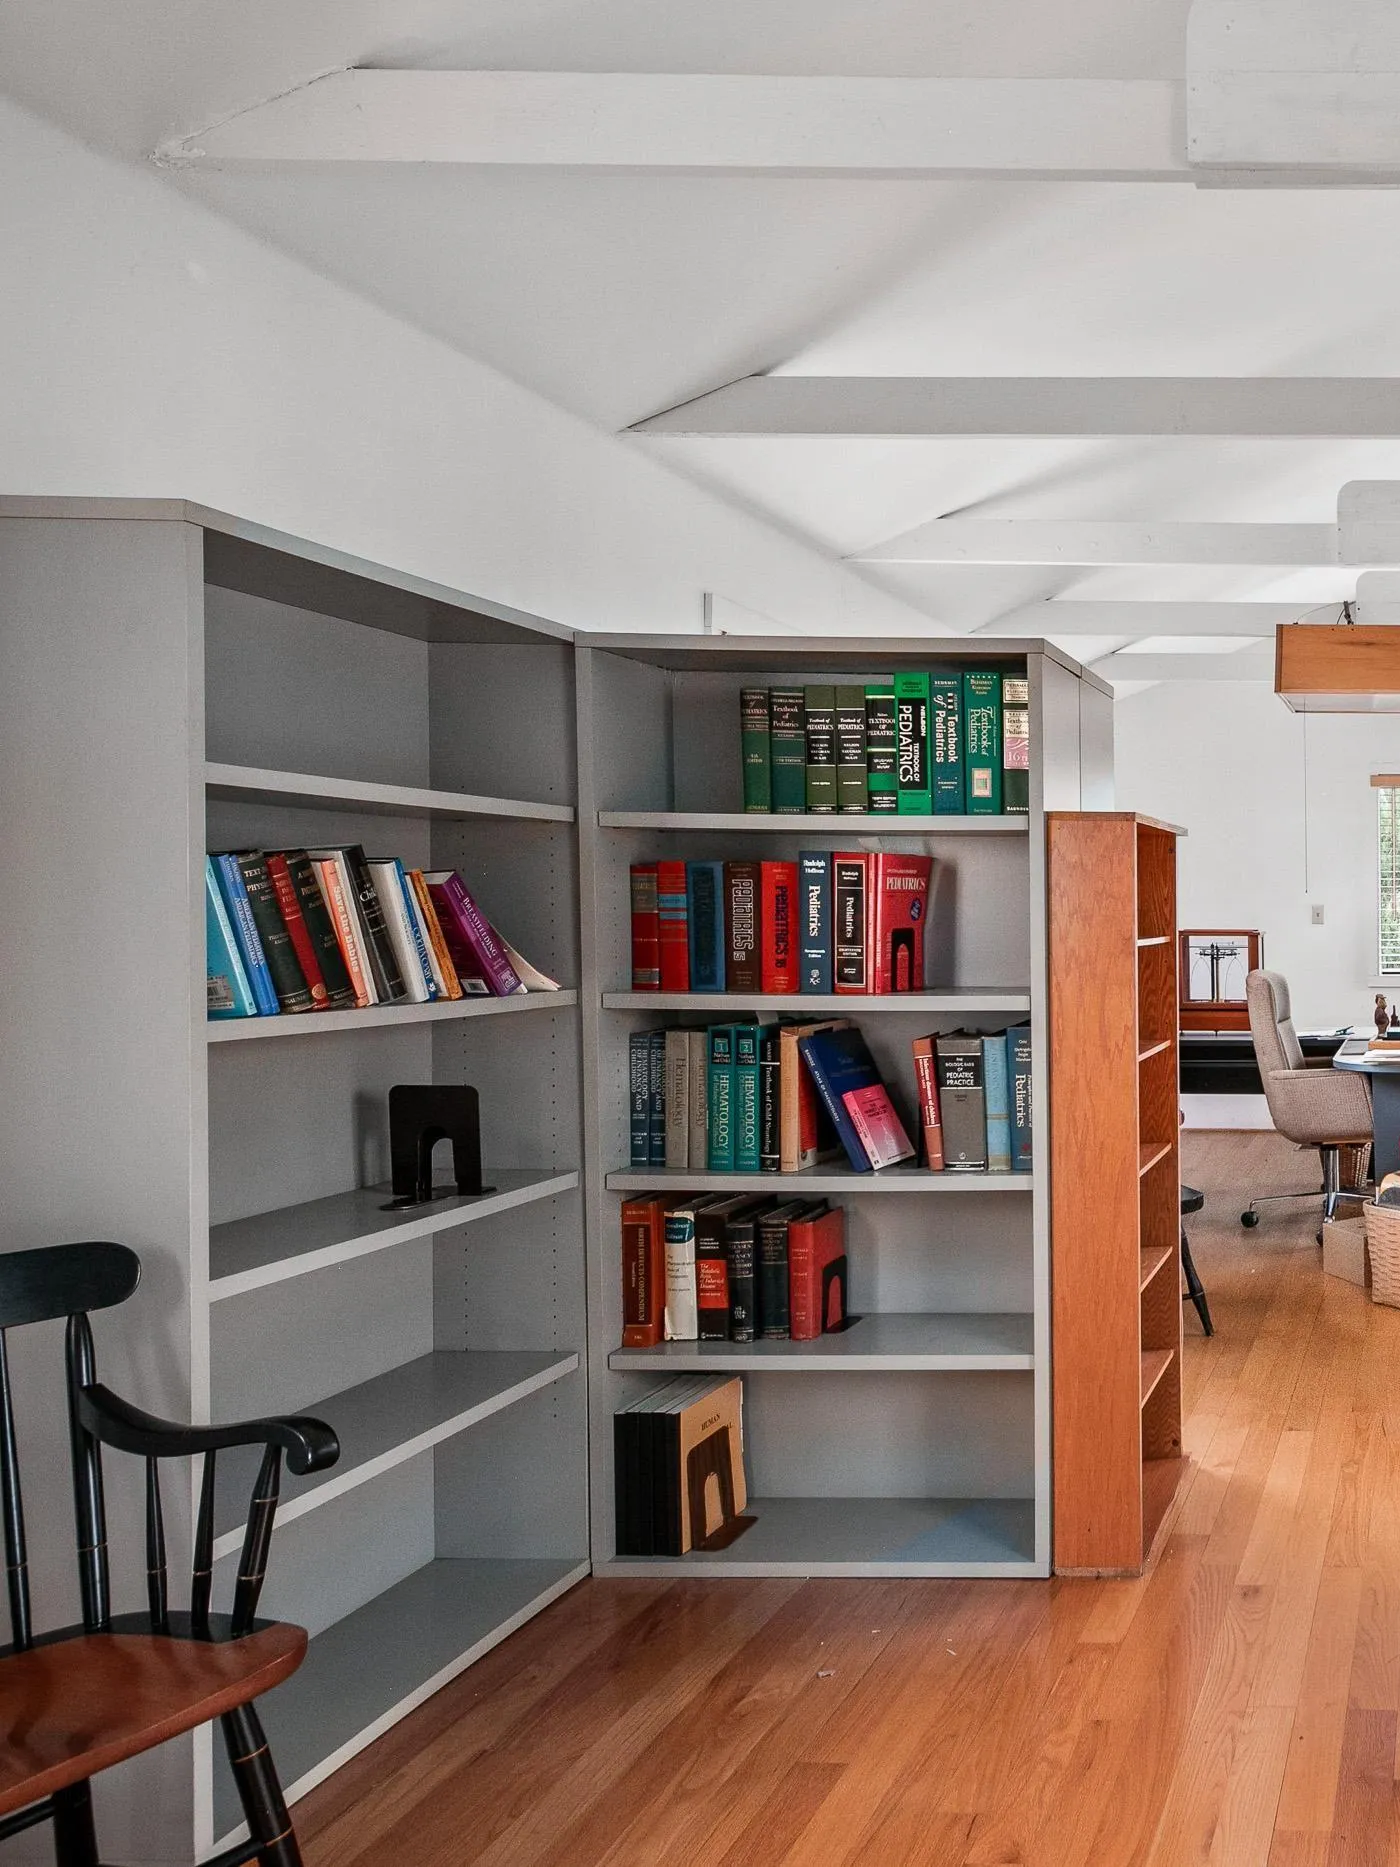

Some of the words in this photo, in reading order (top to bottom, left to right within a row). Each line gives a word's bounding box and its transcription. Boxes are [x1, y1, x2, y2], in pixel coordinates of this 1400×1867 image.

[774, 705, 798, 713] Textbook
[933, 695, 947, 708] of
[899, 706, 913, 782] PEDIATRICS
[936, 710, 946, 763] Pediatrics
[948, 714, 959, 763] Textbook
[970, 709, 980, 753] Pediatrics
[981, 706, 994, 745] Textbook
[913, 773, 920, 782] OF
[886, 876, 926, 890] PEDIATRICS
[233, 896, 248, 930] AMERICAN
[242, 930, 258, 965] PEDIATRICS
[241, 897, 256, 931] AMERICAN
[333, 887, 343, 913] Save
[340, 914, 349, 933] the
[345, 932, 359, 973] Babies
[463, 897, 497, 956] BREASTFEEDING
[732, 879, 754, 950] PEDIATRICS
[808, 885, 821, 937] Pediatrics
[846, 897, 854, 938] Pediatrics
[719, 1075, 729, 1149] HEMATOLOGY
[745, 1075, 755, 1150] HEMATOLOGY
[928, 1105, 936, 1124] children
[1015, 1074, 1027, 1128] Pediatrics
[764, 1122, 772, 1153] Neurology
[701, 1413, 721, 1431] HUMAN
